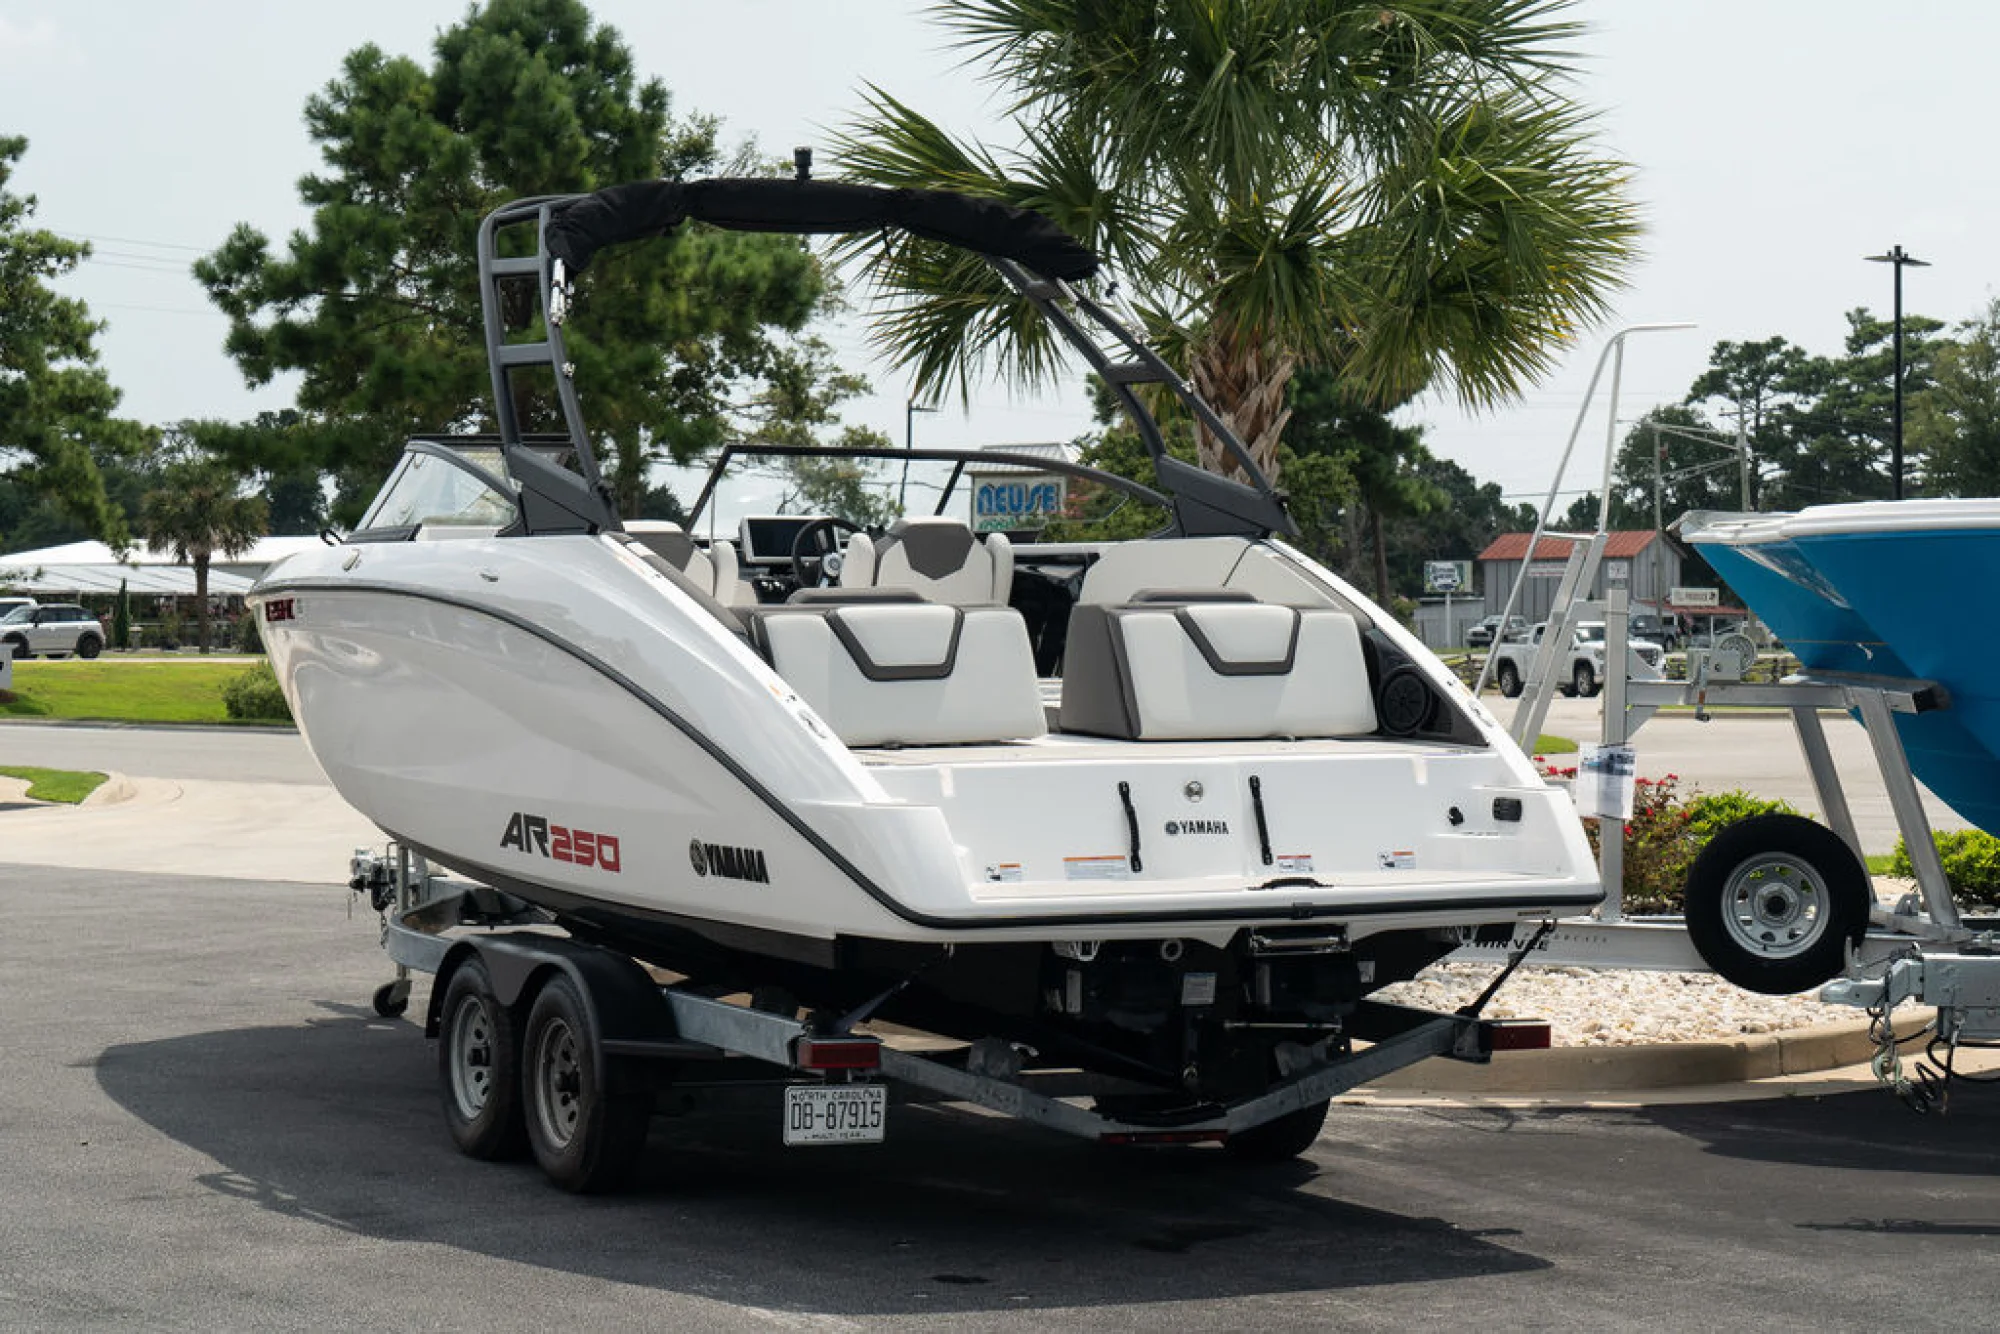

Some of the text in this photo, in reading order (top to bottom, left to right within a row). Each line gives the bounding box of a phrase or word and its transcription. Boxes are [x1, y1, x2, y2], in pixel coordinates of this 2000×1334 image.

[976, 483, 1058, 516] NEUSE
[1180, 820, 1229, 834] YAMAHA
[703, 843, 769, 884] YAMAHA
[790, 1088, 882, 1102] NORTH CAROLINA
